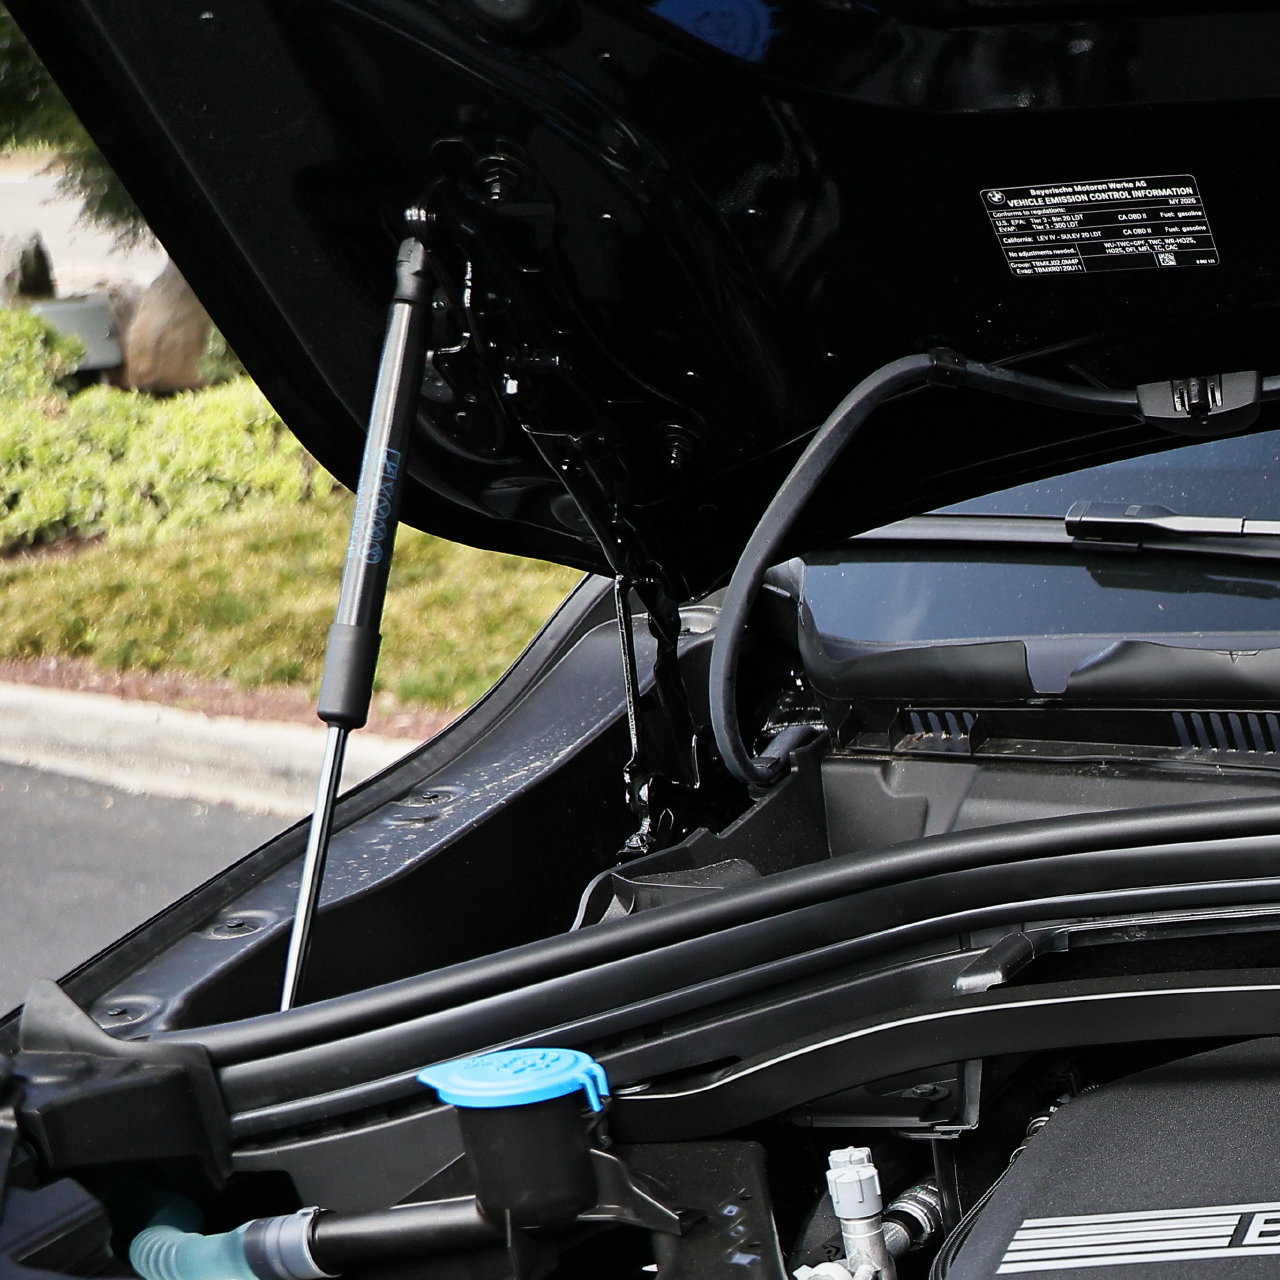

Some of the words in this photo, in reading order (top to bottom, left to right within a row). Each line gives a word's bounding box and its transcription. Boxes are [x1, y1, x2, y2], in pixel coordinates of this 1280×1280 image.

[1007, 198, 1045, 207] VEHICLE
[1046, 194, 1088, 204] EMISSION
[1090, 191, 1131, 201] CONTROL
[1132, 187, 1193, 198] INFORMATION
[1030, 187, 1073, 196] Bayerische
